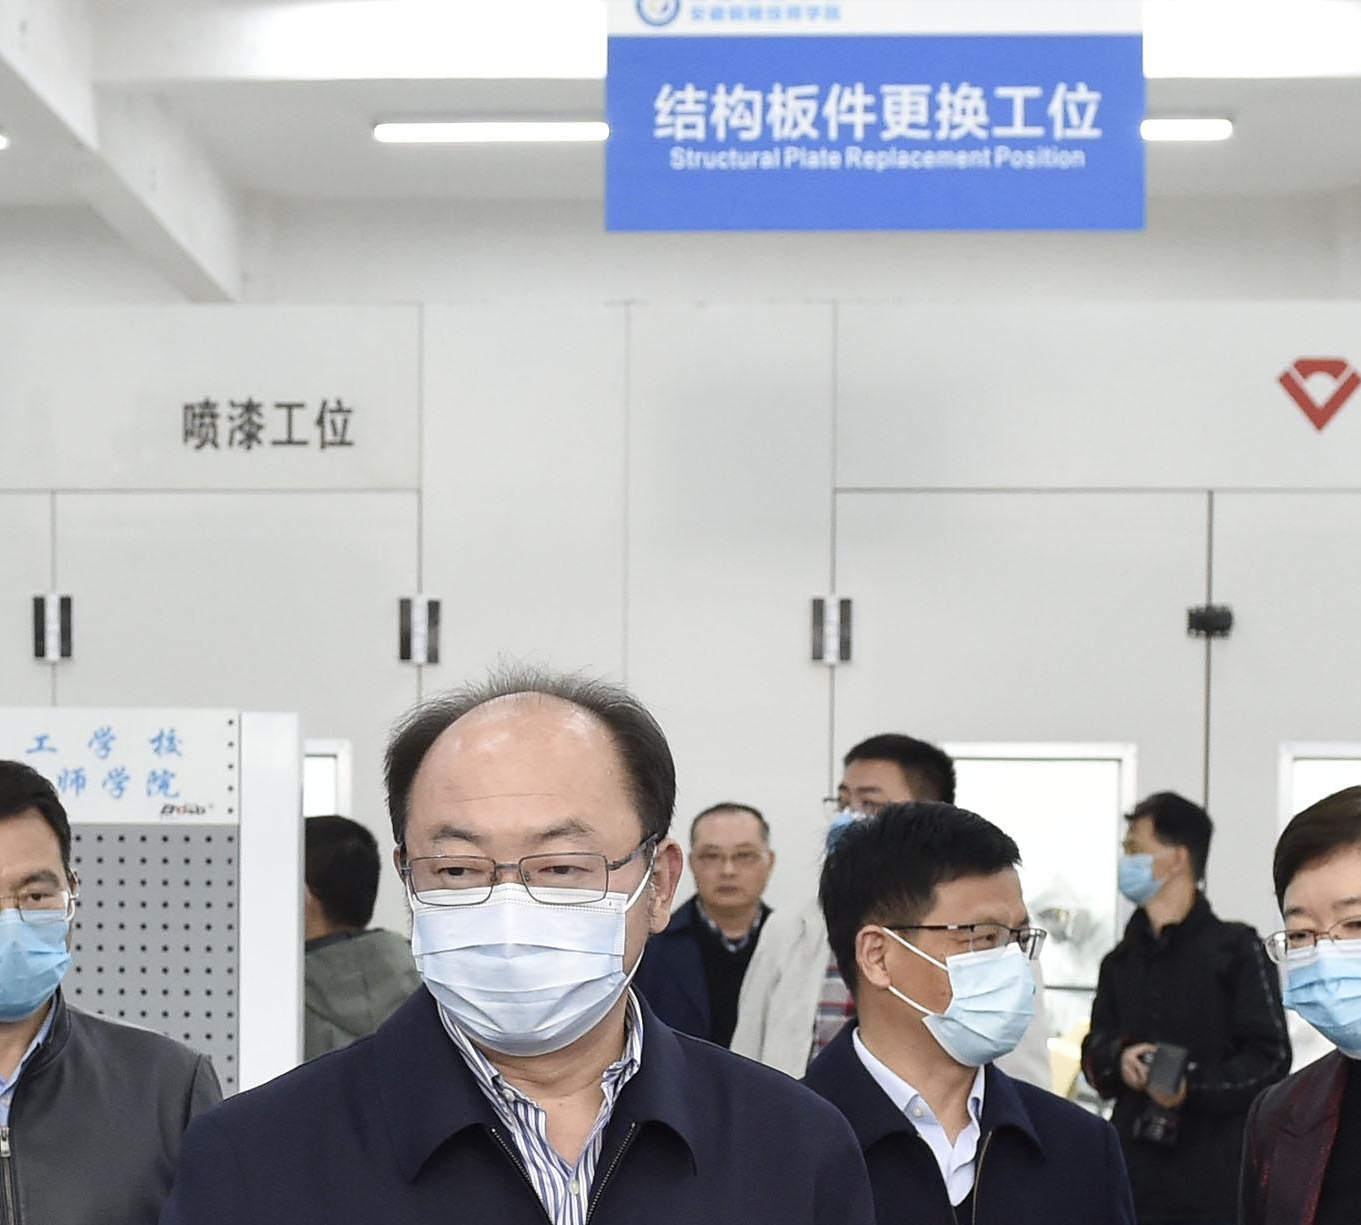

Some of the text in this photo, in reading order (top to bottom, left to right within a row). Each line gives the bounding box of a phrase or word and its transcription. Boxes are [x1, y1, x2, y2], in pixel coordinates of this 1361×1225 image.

[653, 83, 1103, 142] 结构板件更换工位
[670, 145, 1086, 173] Structural Plate Replacement Position
[182, 396, 355, 451] 喷漆工位
